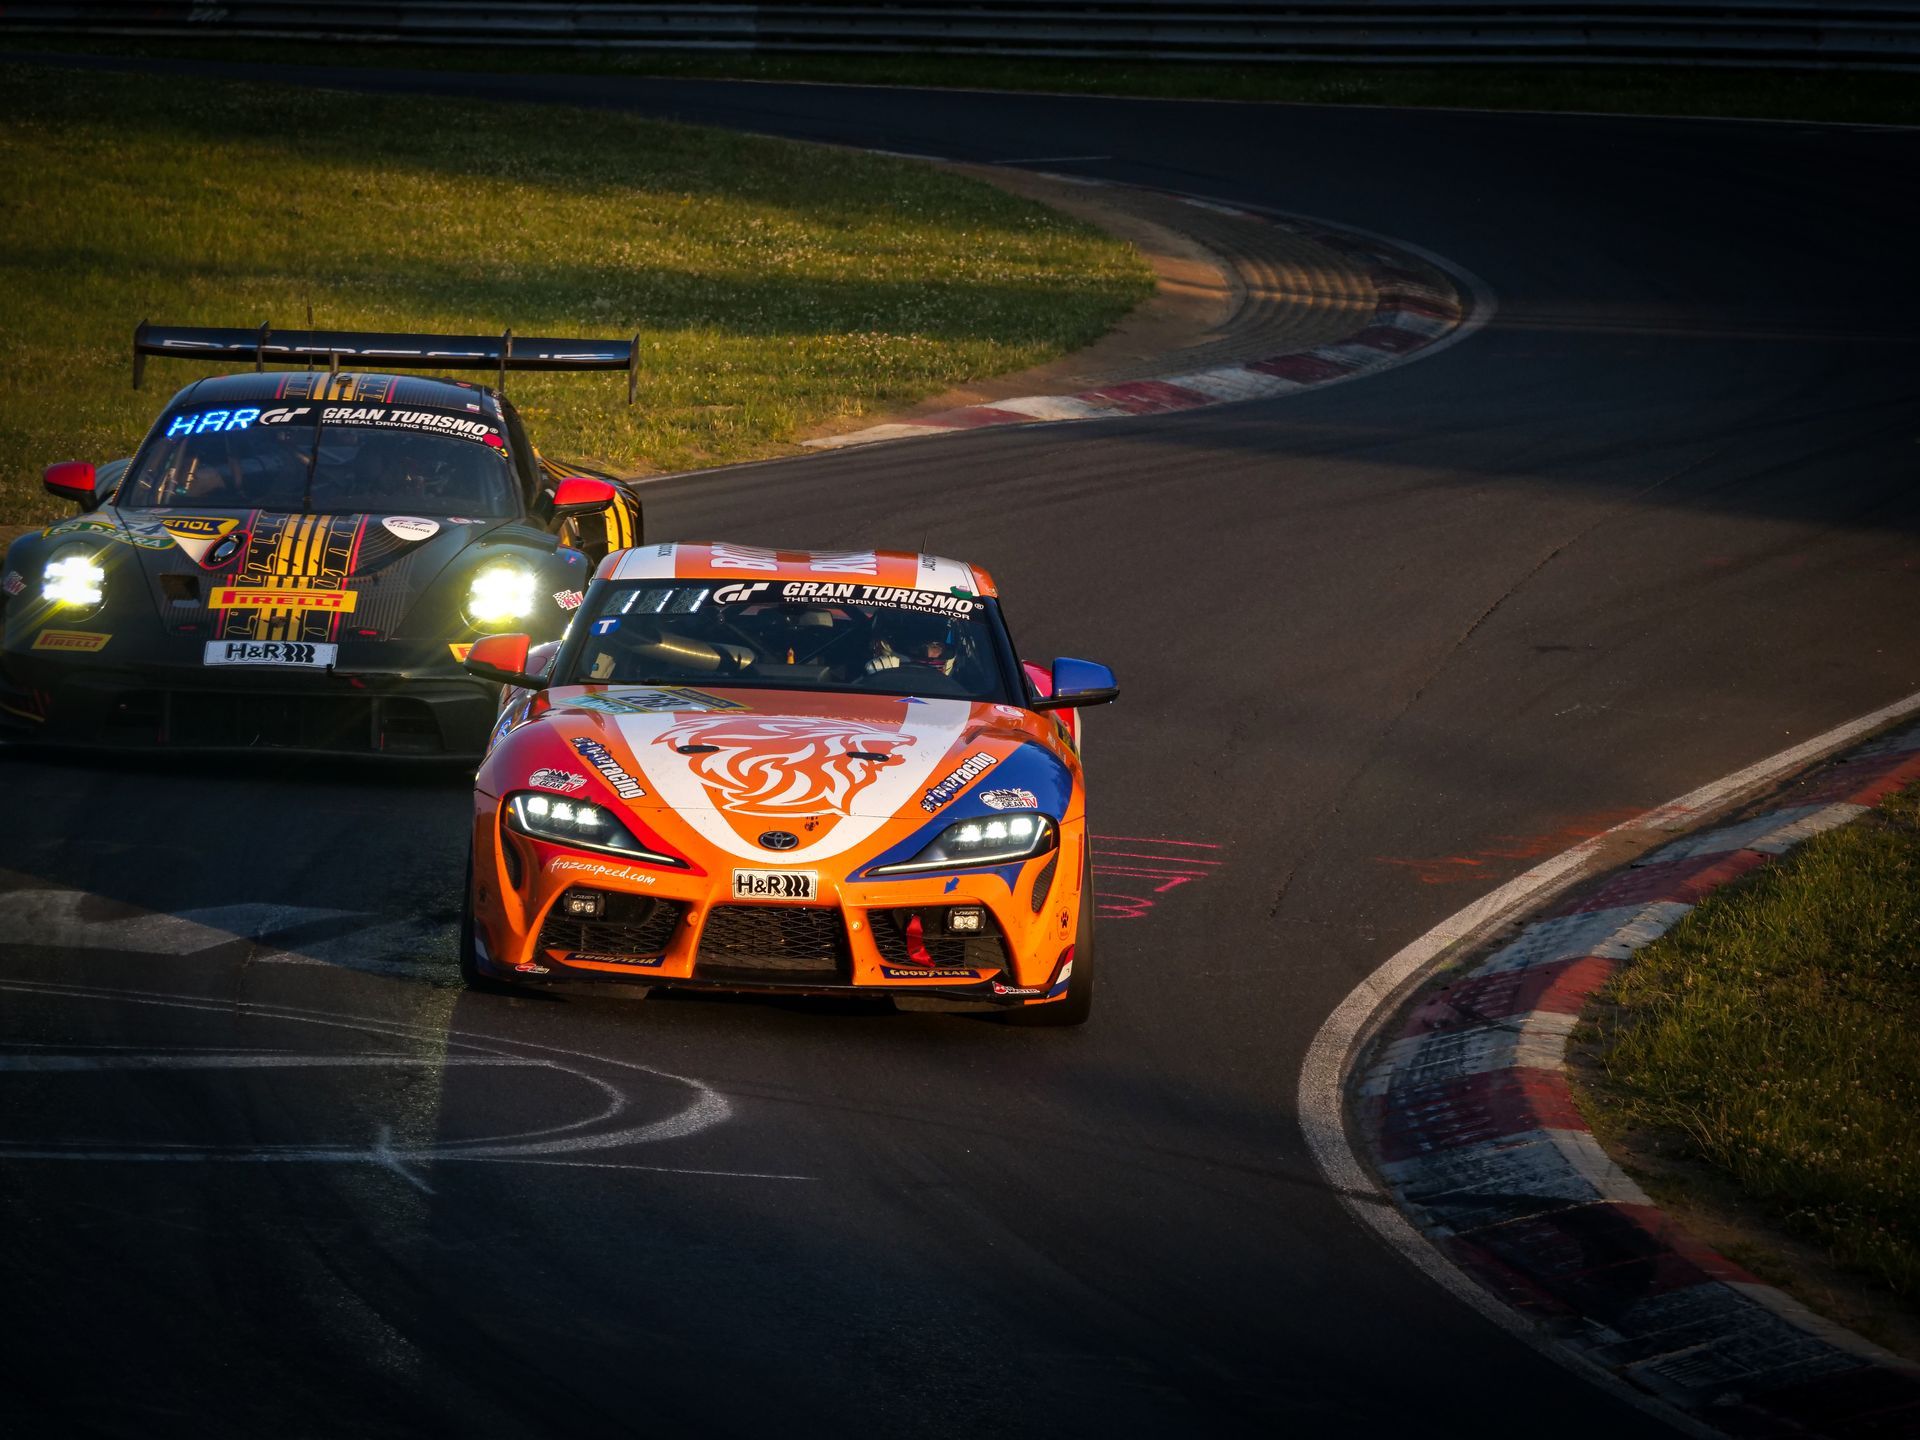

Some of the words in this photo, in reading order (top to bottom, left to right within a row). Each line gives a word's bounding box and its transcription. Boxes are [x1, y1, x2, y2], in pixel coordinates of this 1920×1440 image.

[166, 408, 261, 437] HAR
[323, 407, 384, 421] GRAN
[390, 410, 489, 436] TURISMO
[375, 420, 420, 430] DRIVING
[422, 424, 484, 443] SIMULATOR
[222, 590, 345, 607] PIRELLI
[782, 582, 858, 599] GRAN
[863, 585, 974, 613] TURISMO
[784, 596, 809, 604] THE
[811, 596, 845, 604] REAL
[847, 598, 897, 608] DRIVING
[900, 603, 970, 620] SIMULATOR
[598, 619, 617, 634] T
[40, 633, 104, 649] PIRELLI
[226, 642, 282, 660] H&R
[539, 779, 562, 789] GEAR
[551, 857, 656, 886] frozenspeed.com
[737, 874, 782, 894] H&R
[574, 953, 657, 965] GOODYEAR
[889, 968, 970, 978] GOODYEAR
